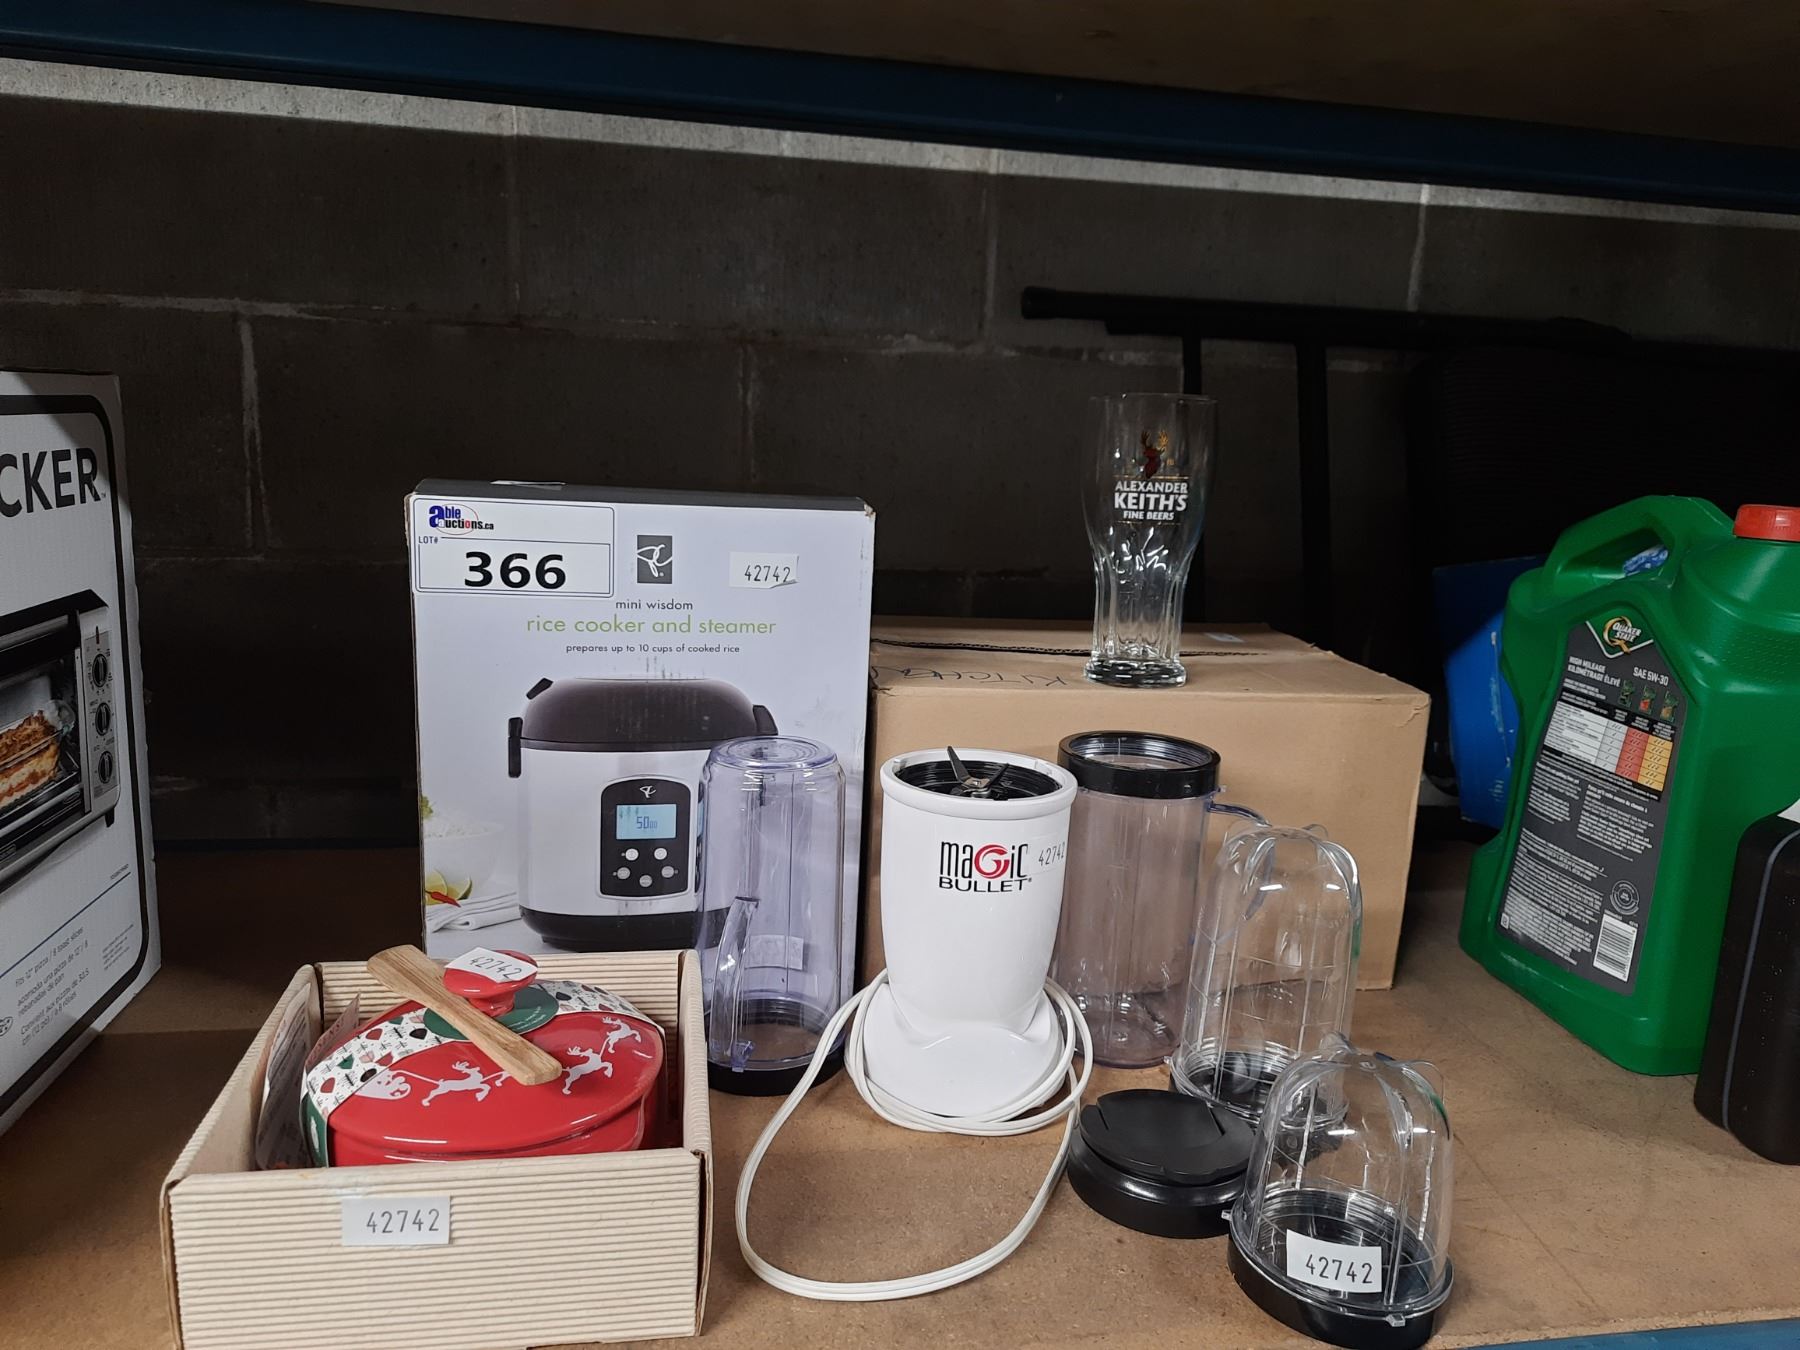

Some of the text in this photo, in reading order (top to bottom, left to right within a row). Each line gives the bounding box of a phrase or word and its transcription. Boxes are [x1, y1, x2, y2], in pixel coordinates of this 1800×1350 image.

[1114, 480, 1188, 494] ALEXANDER
[1114, 492, 1189, 512] KEITH'S
[1123, 510, 1175, 521] FINE BEERS
[418, 536, 439, 544] LOT#
[464, 551, 567, 589] 366
[744, 564, 792, 584] 42742
[615, 598, 693, 611] mini wisdom
[527, 614, 776, 634] rice cooker and steamer
[1612, 622, 1642, 637] QUAKER
[1614, 631, 1636, 643] STATE
[566, 643, 740, 654] prepares up to 10 cups of cooked rice
[1582, 659, 1606, 674] MILEAGE
[1633, 666, 1669, 686] SAE 5W-30
[1038, 841, 1065, 867] 42742
[939, 876, 1029, 893] BULLET
[468, 956, 523, 980] 42742
[366, 1208, 441, 1234] 42742
[1305, 1253, 1374, 1284] 42742
